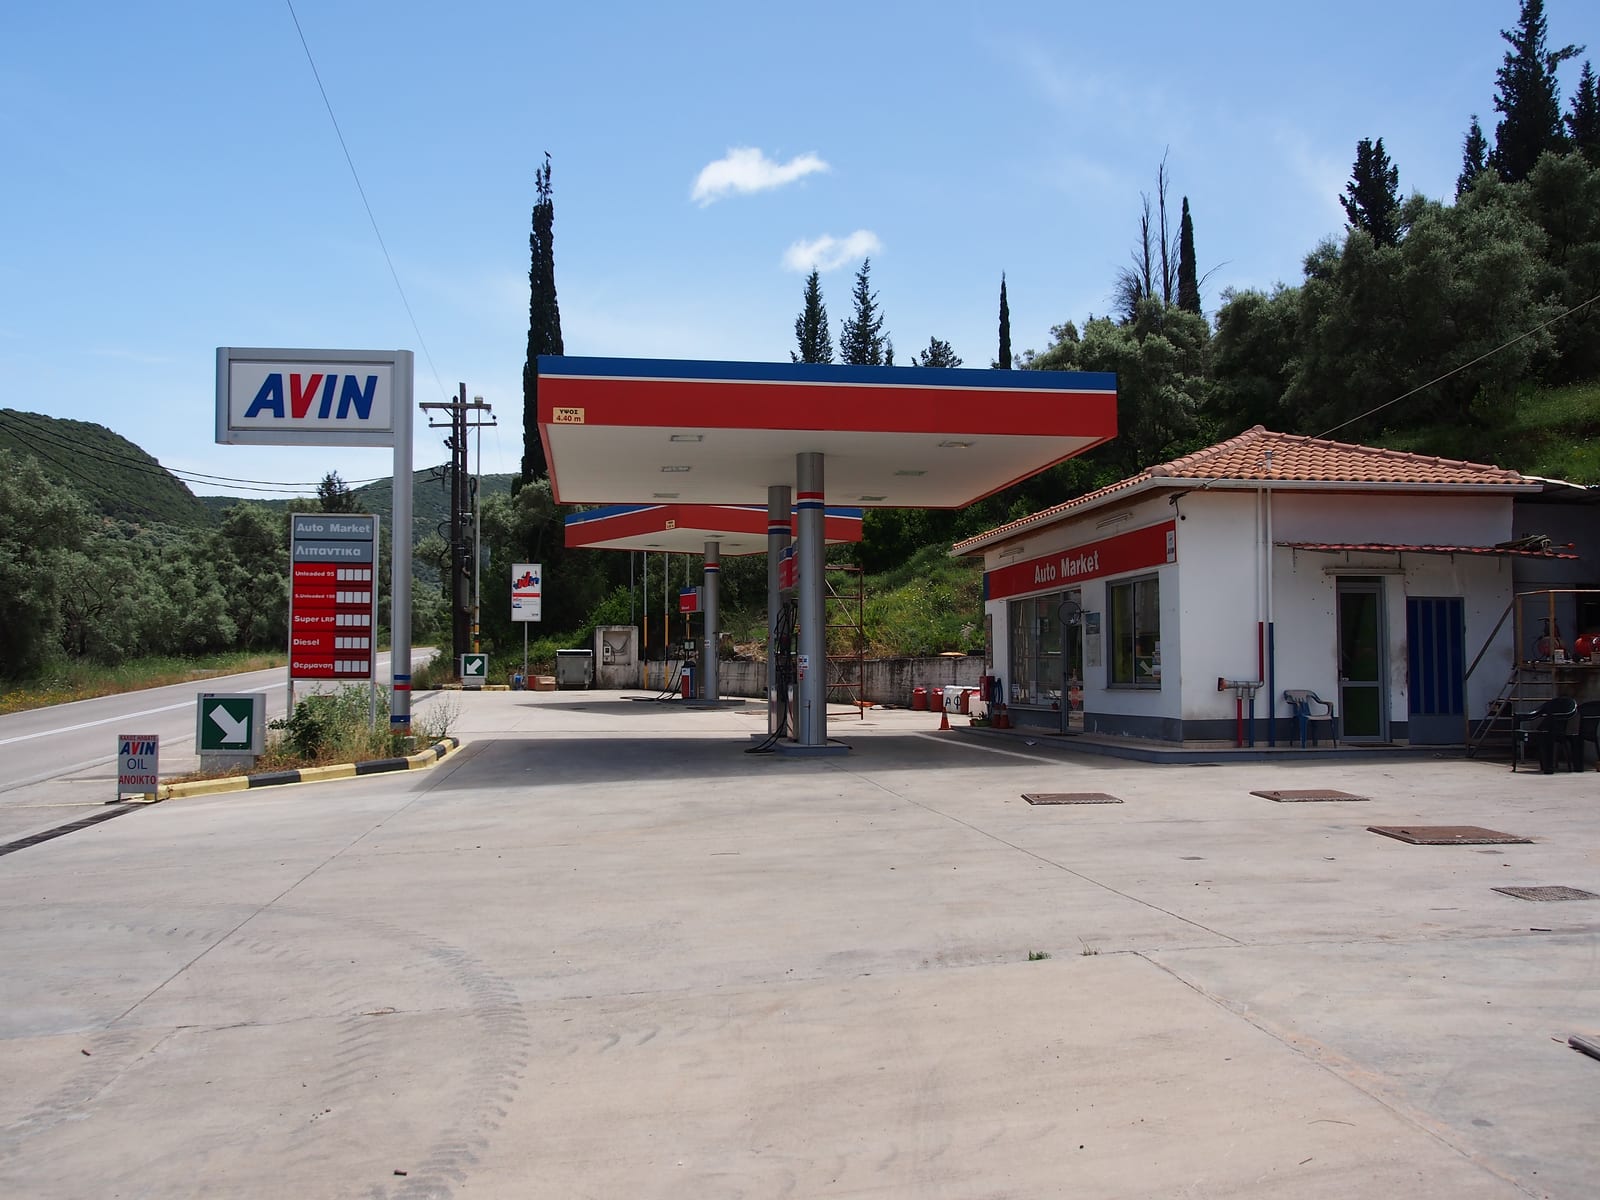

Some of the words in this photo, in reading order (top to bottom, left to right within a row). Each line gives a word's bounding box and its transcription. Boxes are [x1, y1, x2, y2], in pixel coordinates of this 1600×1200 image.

[244, 373, 378, 420] AVIN
[296, 523, 324, 532] Auto
[329, 523, 370, 533] Market
[1034, 563, 1056, 584] Auto
[1061, 550, 1099, 578] Market
[294, 615, 319, 623] Super
[120, 741, 156, 755] AVIN
[127, 758, 147, 770] OIL
